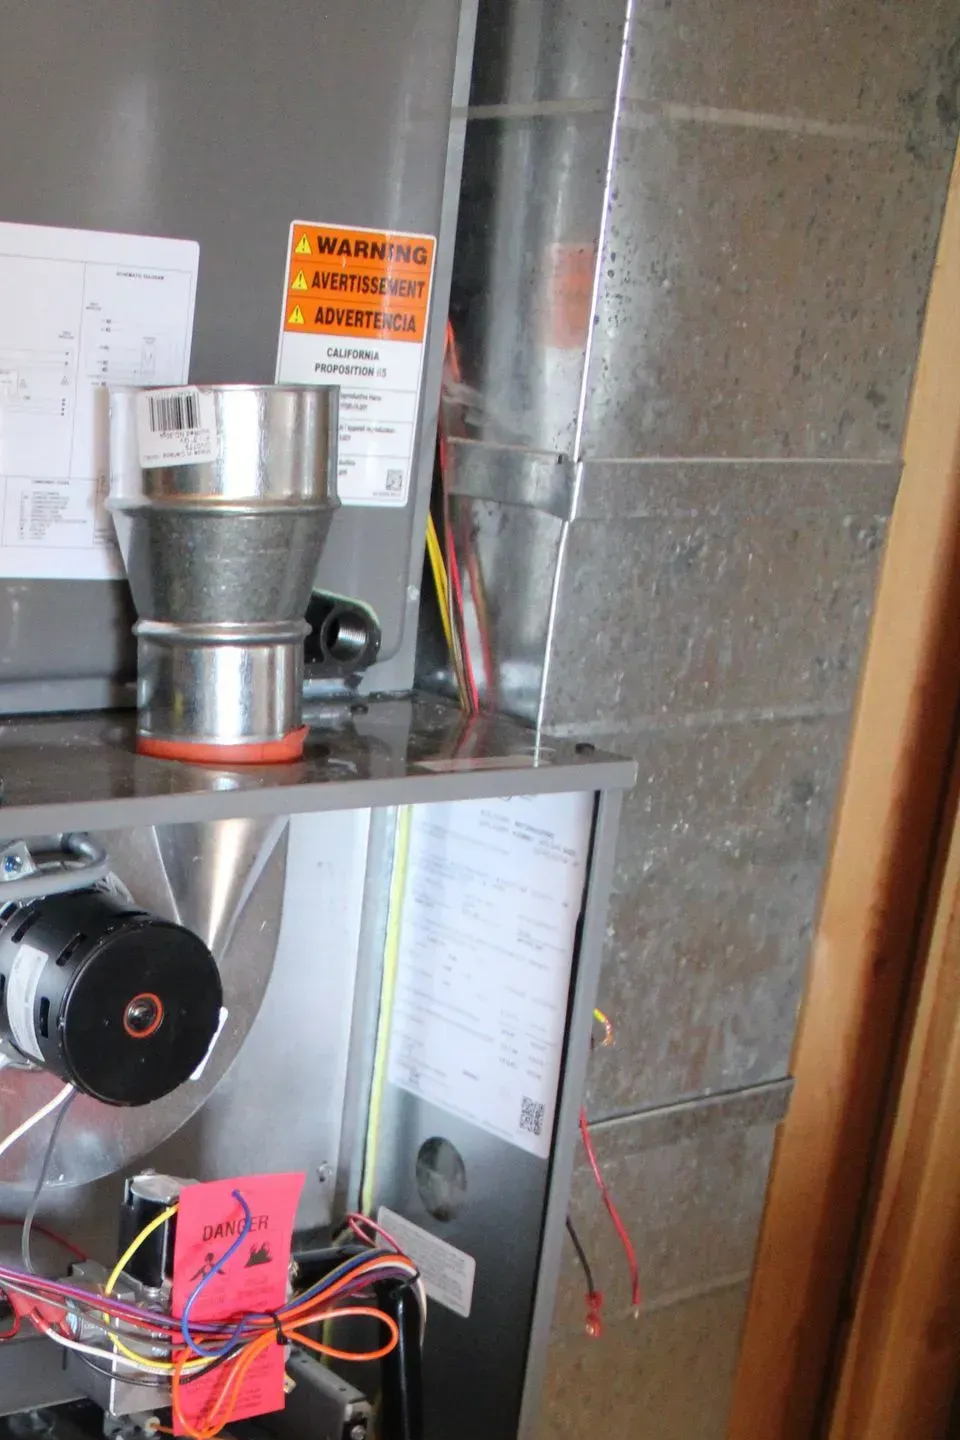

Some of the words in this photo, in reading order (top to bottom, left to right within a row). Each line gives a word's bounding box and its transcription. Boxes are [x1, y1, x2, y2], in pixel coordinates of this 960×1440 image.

[316, 235, 428, 265] WARNING
[311, 271, 426, 299] AVERTISSEMENT
[314, 306, 417, 333] ADVERTENCIA
[326, 347, 380, 361] CALIFORNIA
[314, 363, 375, 377] PROPOSITION
